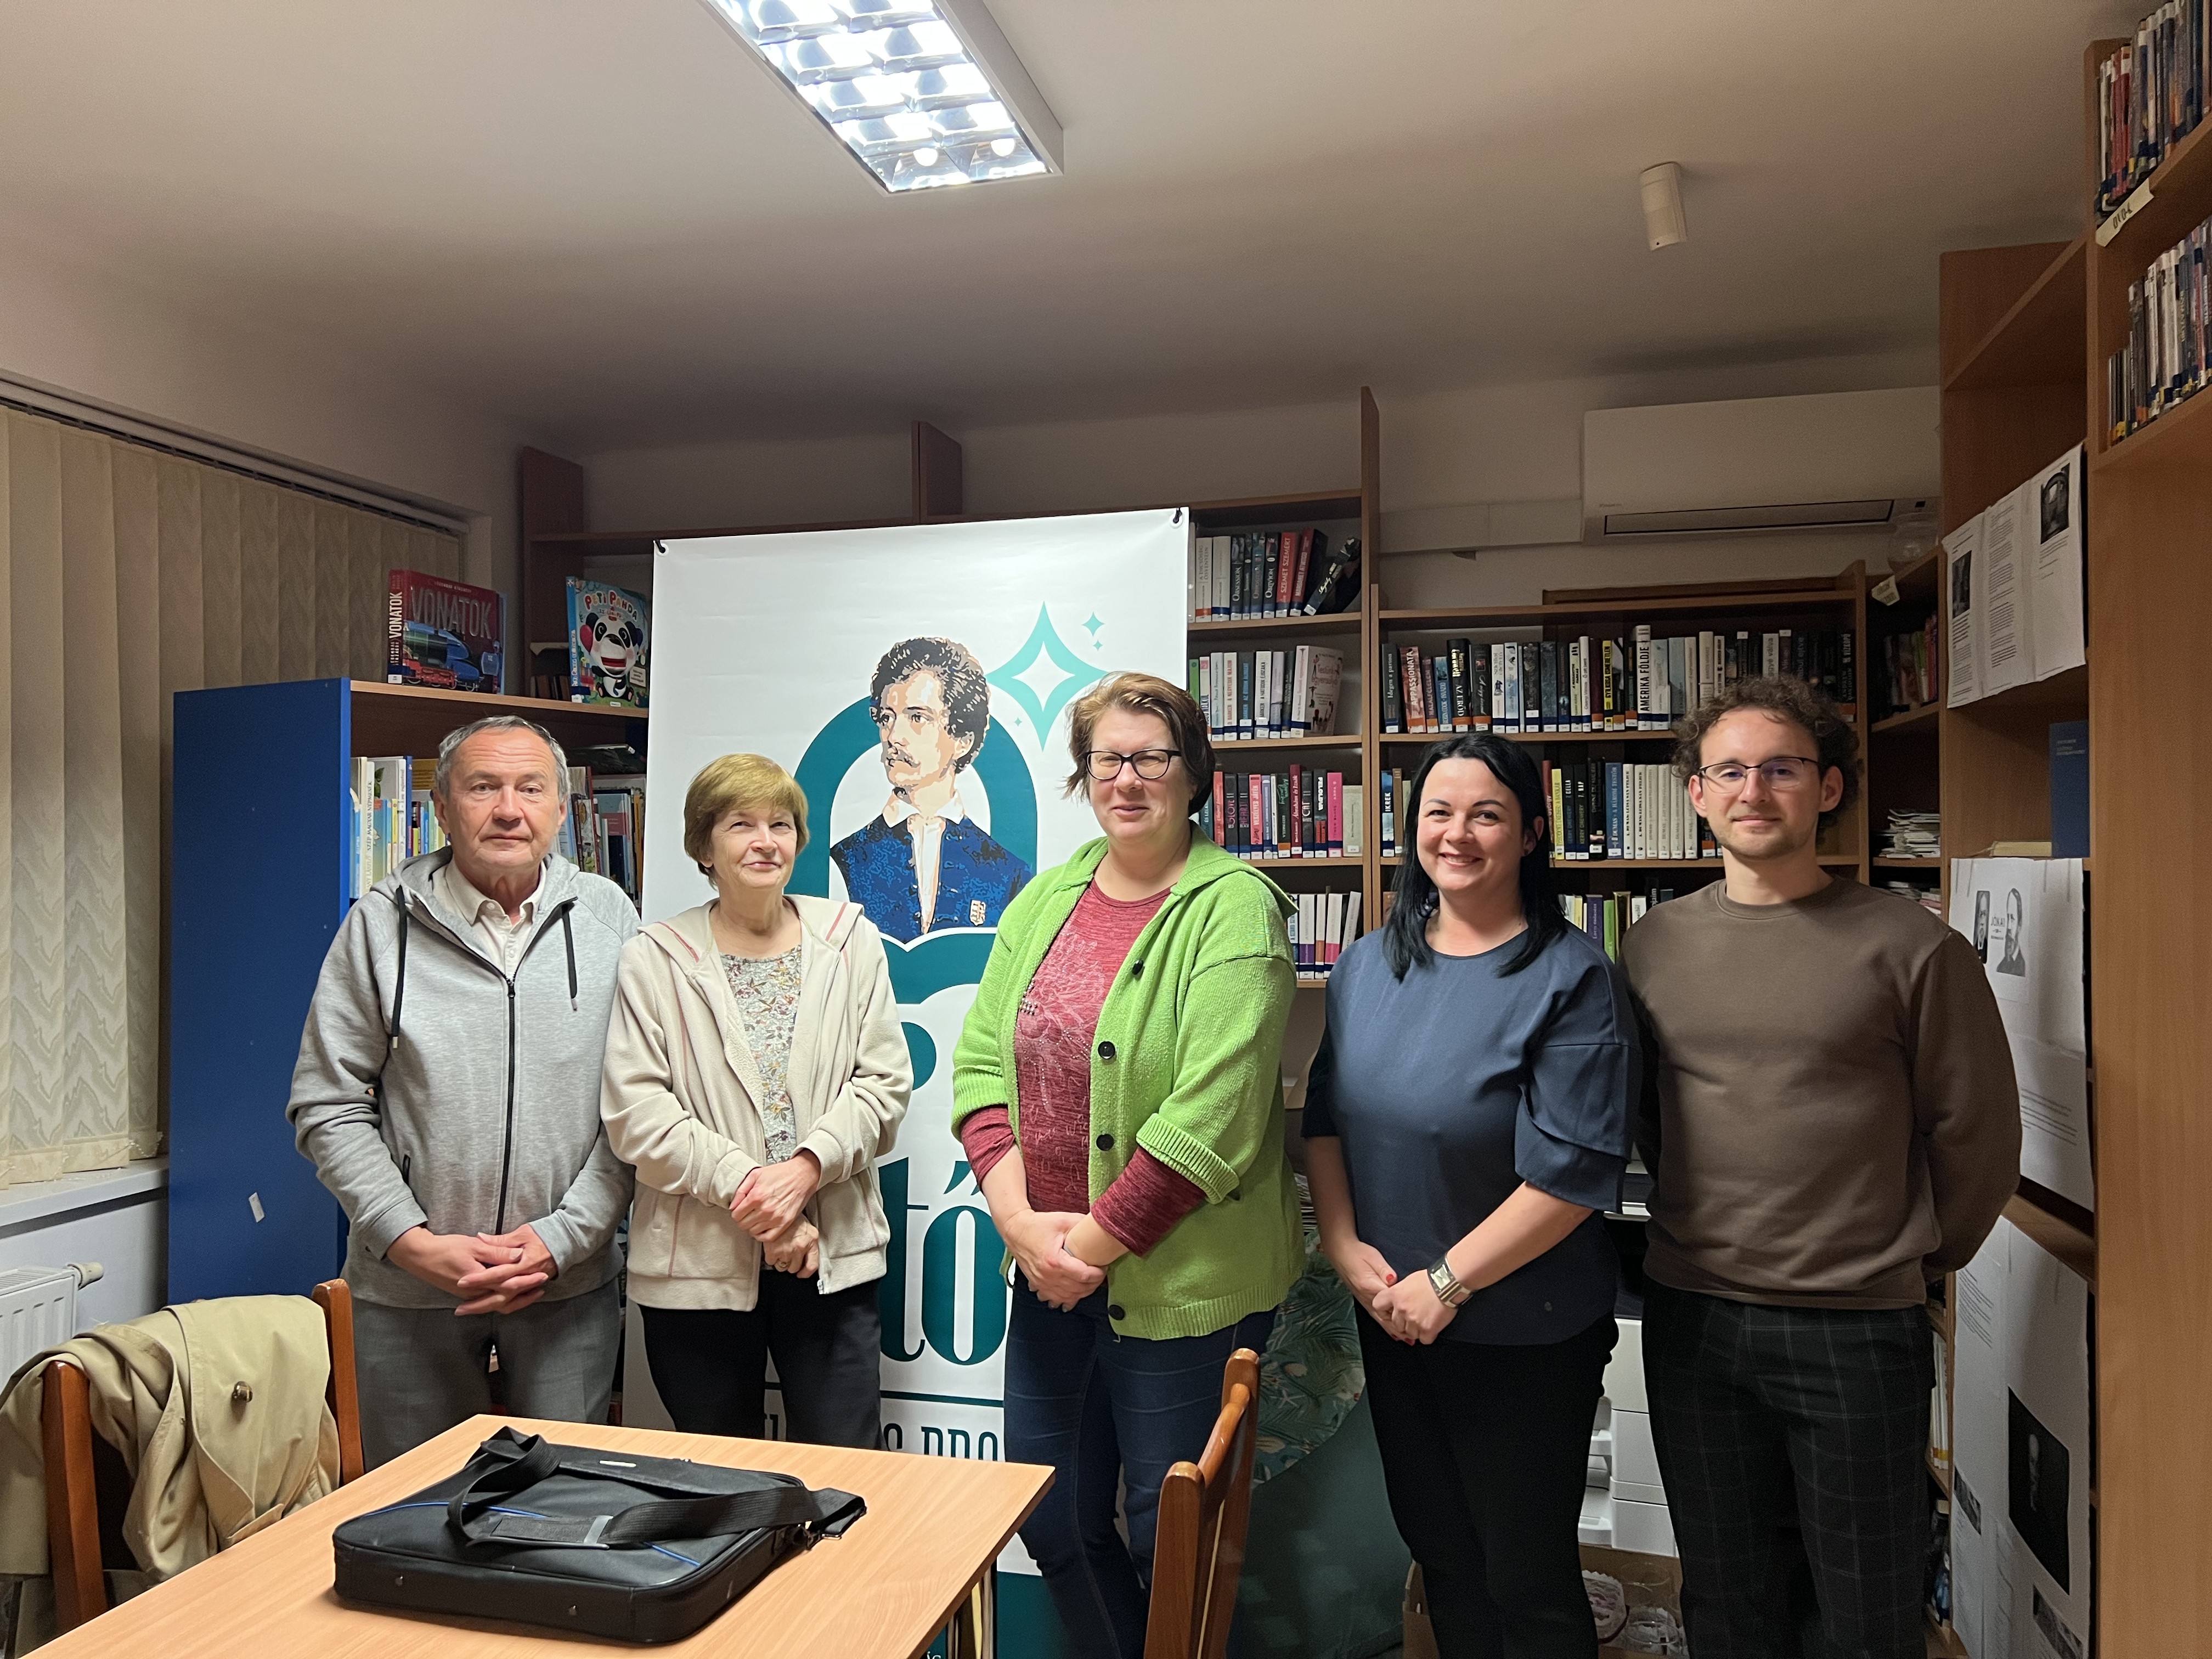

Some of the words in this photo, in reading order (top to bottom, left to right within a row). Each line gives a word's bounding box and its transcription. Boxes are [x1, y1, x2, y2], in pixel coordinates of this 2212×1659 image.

[1282, 537, 1290, 566] SZEMÉRT
[1299, 552, 1307, 571] ATWOOD
[1232, 567, 1242, 601] OBSESSION
[1265, 568, 1274, 598] OBLIVION
[1295, 572, 1305, 596] MARGARET
[389, 591, 402, 638] VONATOK
[410, 586, 492, 640] VONATOK
[584, 591, 607, 610] PETI
[608, 590, 637, 621] PANDA
[1638, 647, 1649, 673] FÖLDJE
[1406, 651, 1418, 706] APPASSIONATA
[1425, 669, 1434, 715] HALÁLFÉLELEM
[1456, 684, 1463, 696] AZ
[1456, 696, 1466, 716] ERŐD
[1640, 676, 1650, 711] AMERIKA
[1250, 785, 1259, 799] JÁTÉK
[1226, 800, 1235, 825] GLOVE
[1250, 800, 1259, 826] VESZÉLYES
[1301, 801, 1311, 816] CAT
